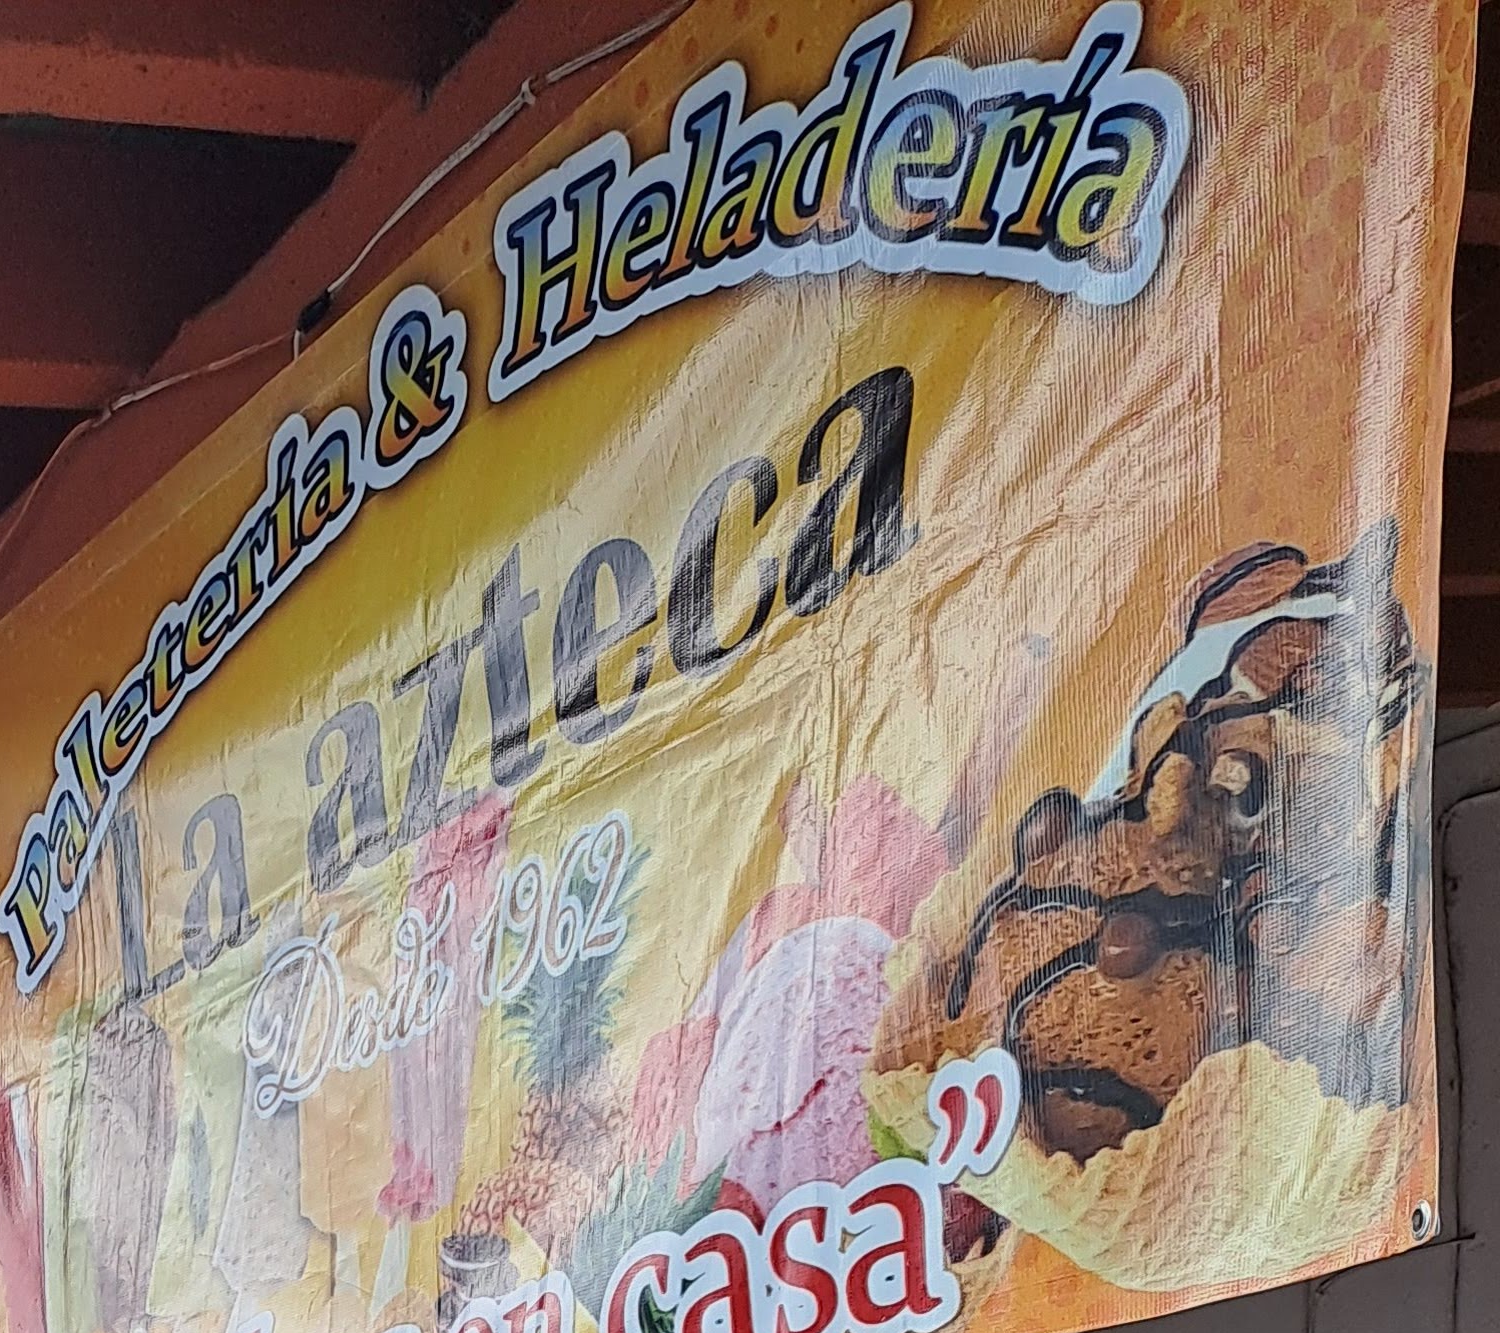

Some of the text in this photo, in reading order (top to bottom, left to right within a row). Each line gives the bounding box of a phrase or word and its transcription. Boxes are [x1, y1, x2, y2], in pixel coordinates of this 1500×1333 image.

[2, 29, 1171, 977] Paletería & Heladería
[92, 365, 921, 1026] La azteca
[244, 809, 631, 1118] Desde 1962
